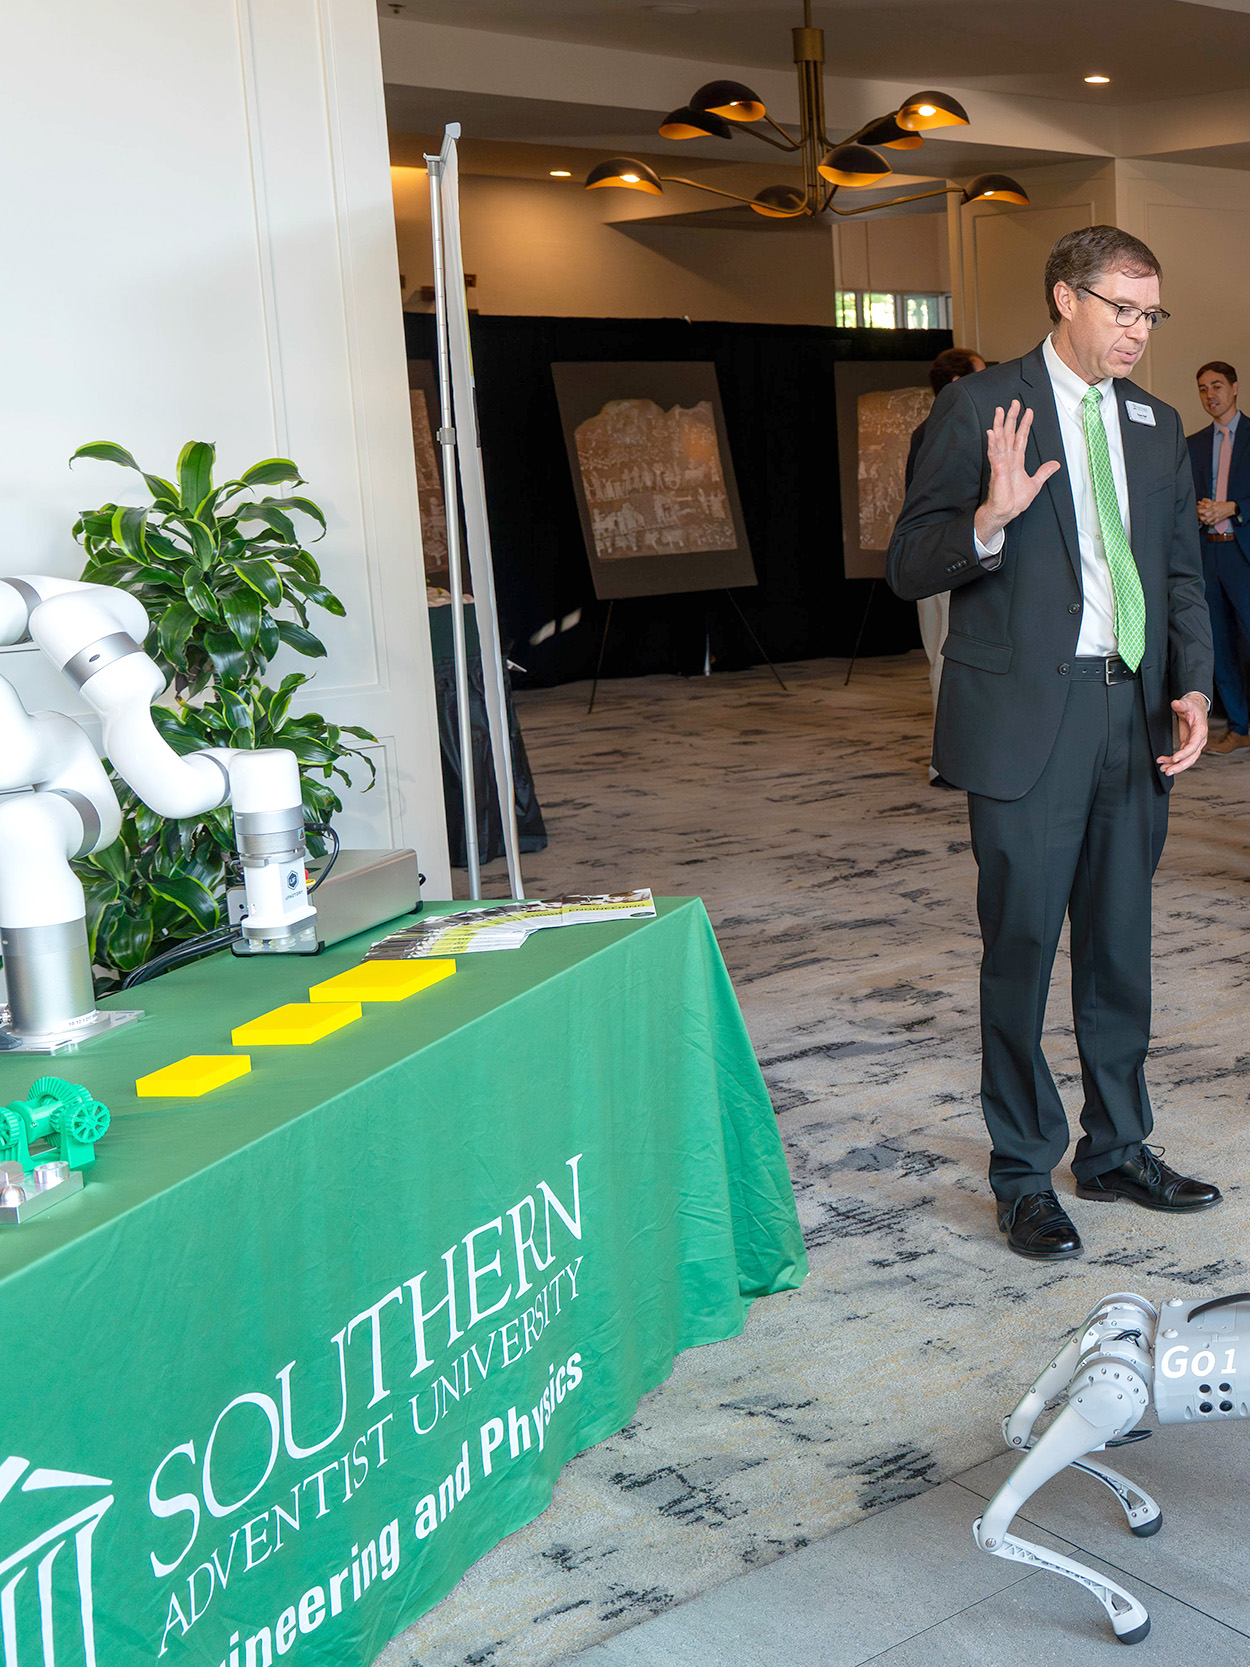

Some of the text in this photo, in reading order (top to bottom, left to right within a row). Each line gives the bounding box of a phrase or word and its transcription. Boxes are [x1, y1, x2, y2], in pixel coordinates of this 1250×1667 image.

[148, 1153, 583, 1578] SOUTHERN
[157, 1256, 584, 1658] ADVENTIST UNIVERSITY
[219, 1352, 583, 1667] ineering and Physics
